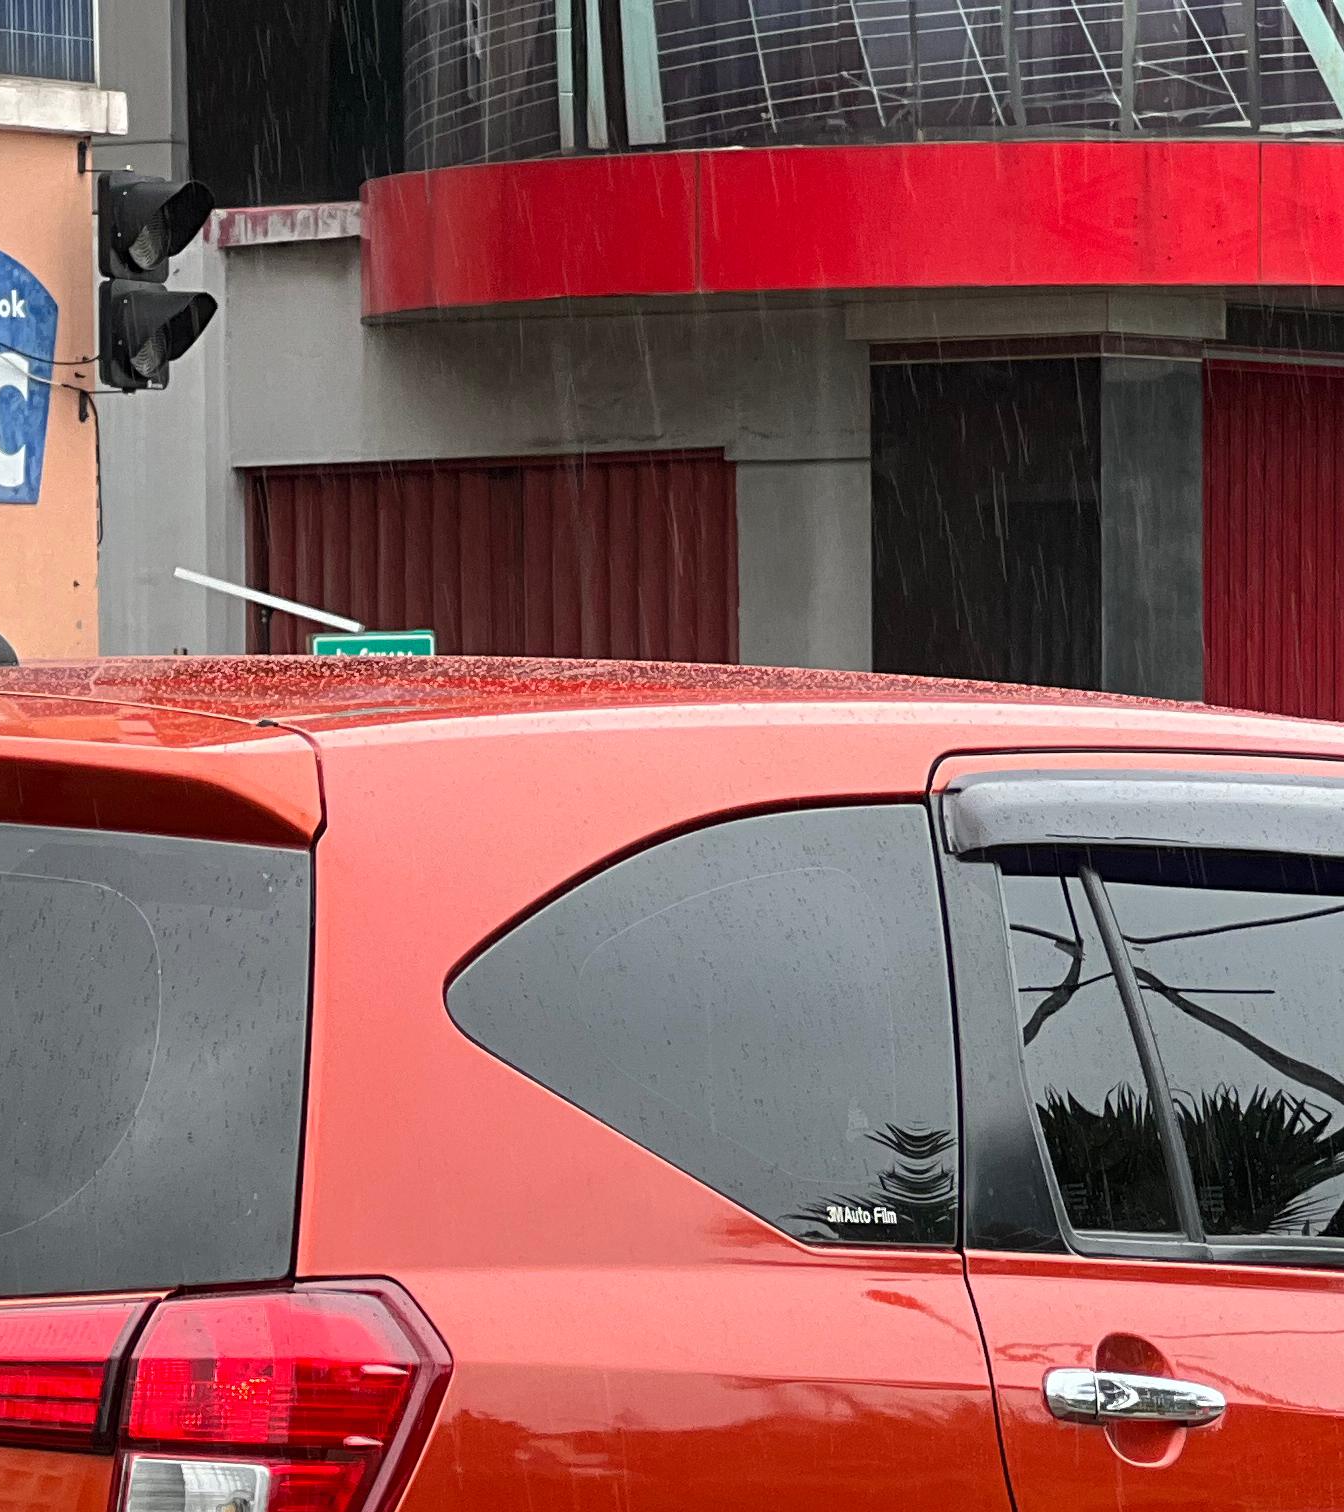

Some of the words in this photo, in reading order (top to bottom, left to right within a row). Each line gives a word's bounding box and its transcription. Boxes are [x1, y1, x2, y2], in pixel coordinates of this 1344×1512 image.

[826, 1206, 844, 1223] 3M
[844, 1206, 871, 1223] Auto
[873, 1207, 897, 1224] Film
